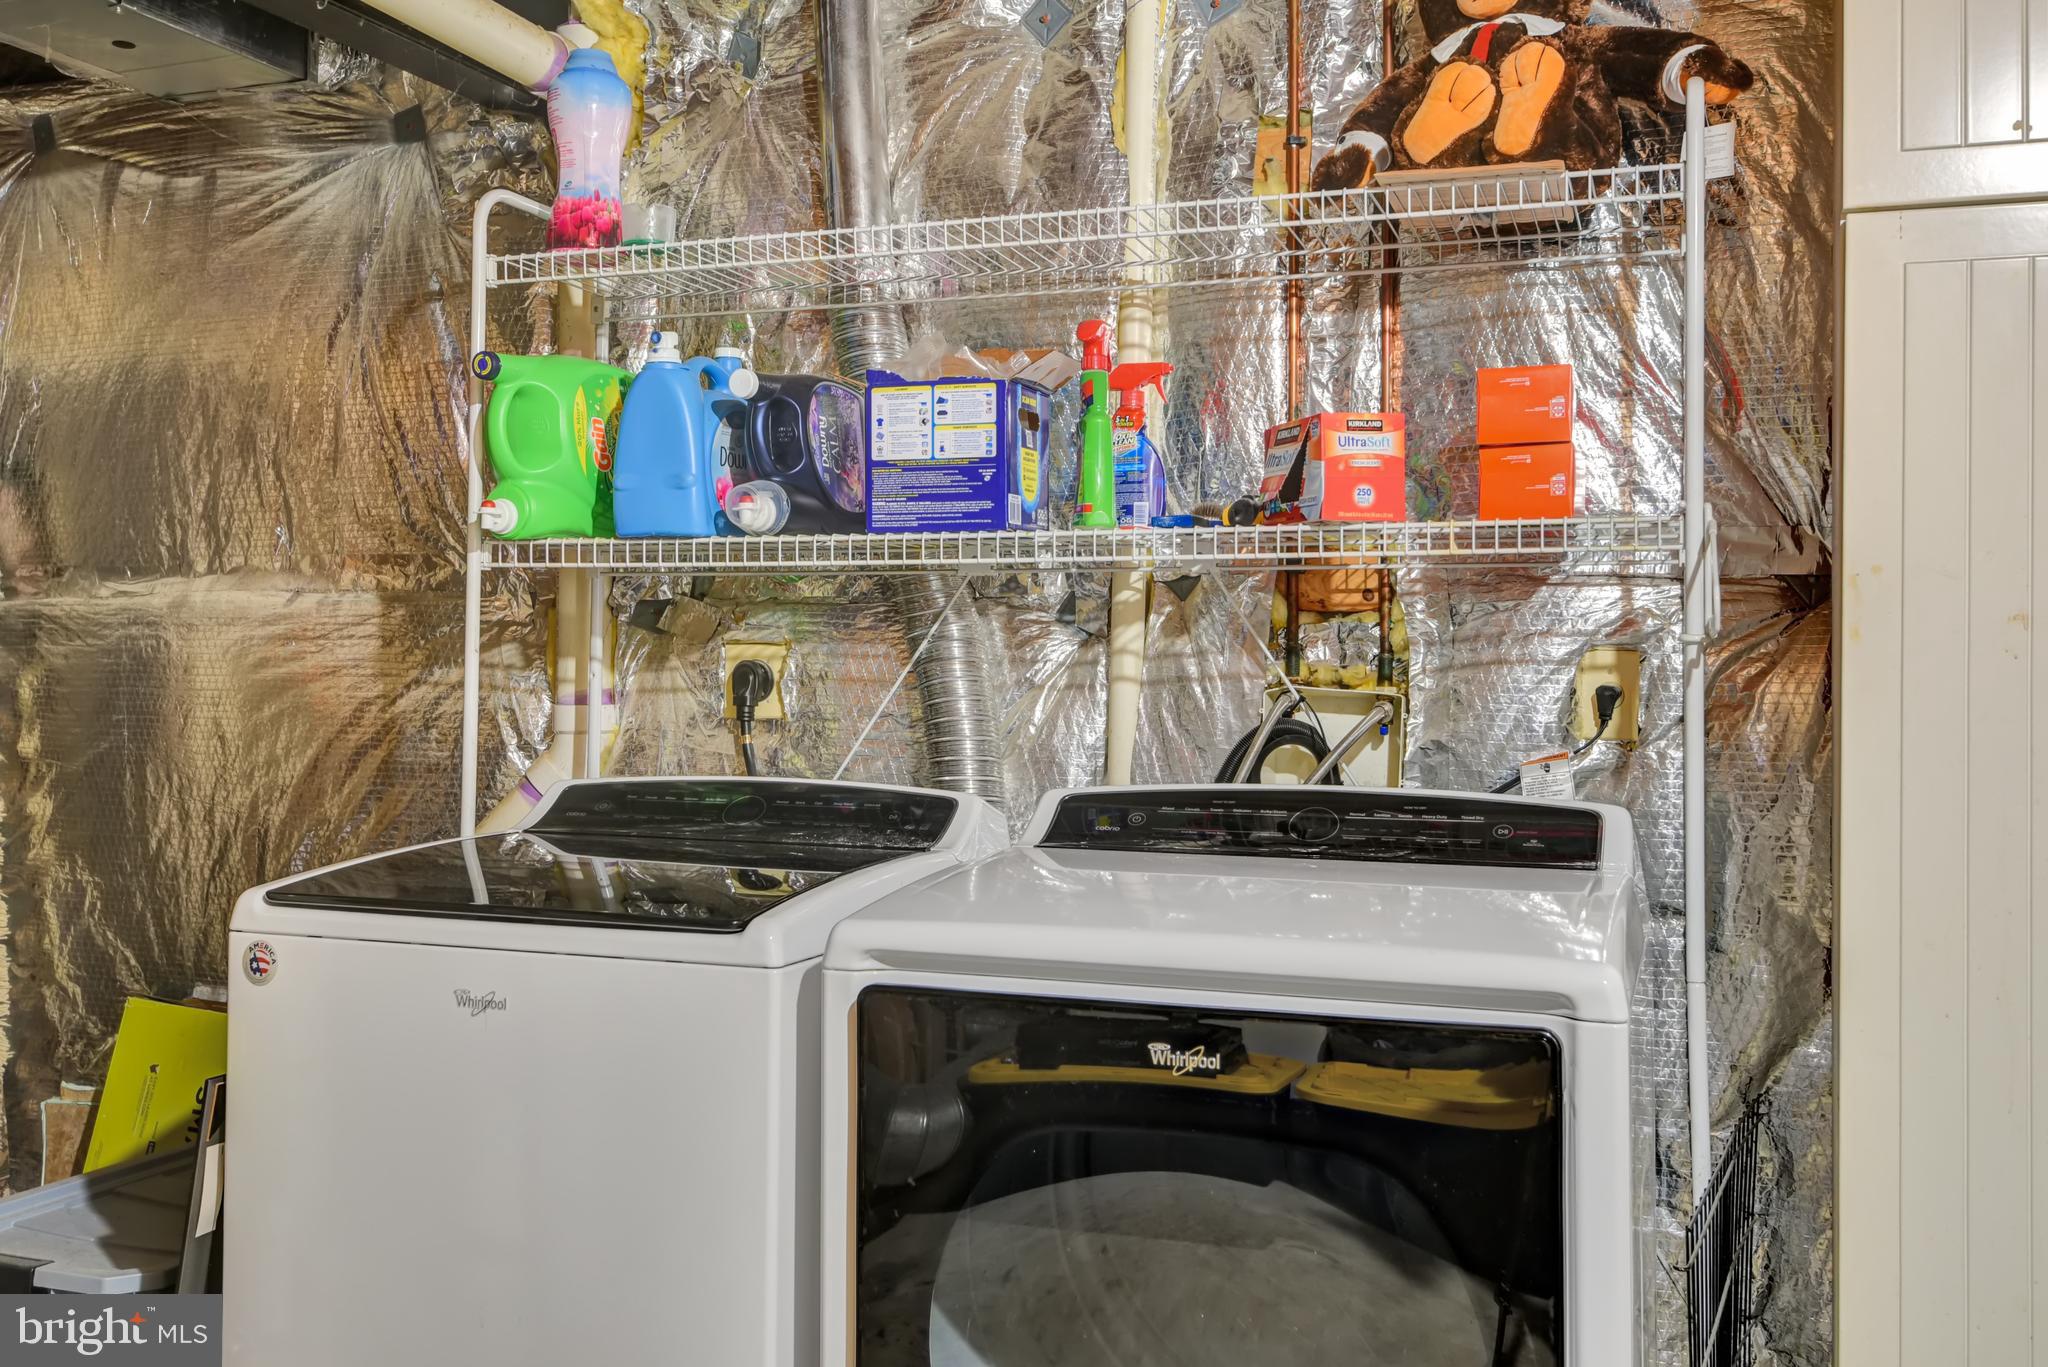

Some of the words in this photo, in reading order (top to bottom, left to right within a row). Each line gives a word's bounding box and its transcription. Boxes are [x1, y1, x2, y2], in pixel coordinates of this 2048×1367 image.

[1348, 420, 1382, 428] KIRKLAND
[591, 417, 612, 472] Gain
[818, 415, 830, 468] Downy
[829, 416, 842, 474] CALM
[1338, 435, 1390, 448] UltraSoft
[1356, 487, 1372, 496] 250
[1095, 824, 1121, 832] cabrio
[249, 942, 277, 965] AMERICA
[454, 990, 507, 1014] Whirlpool
[1148, 1044, 1221, 1074] Whirlpool
